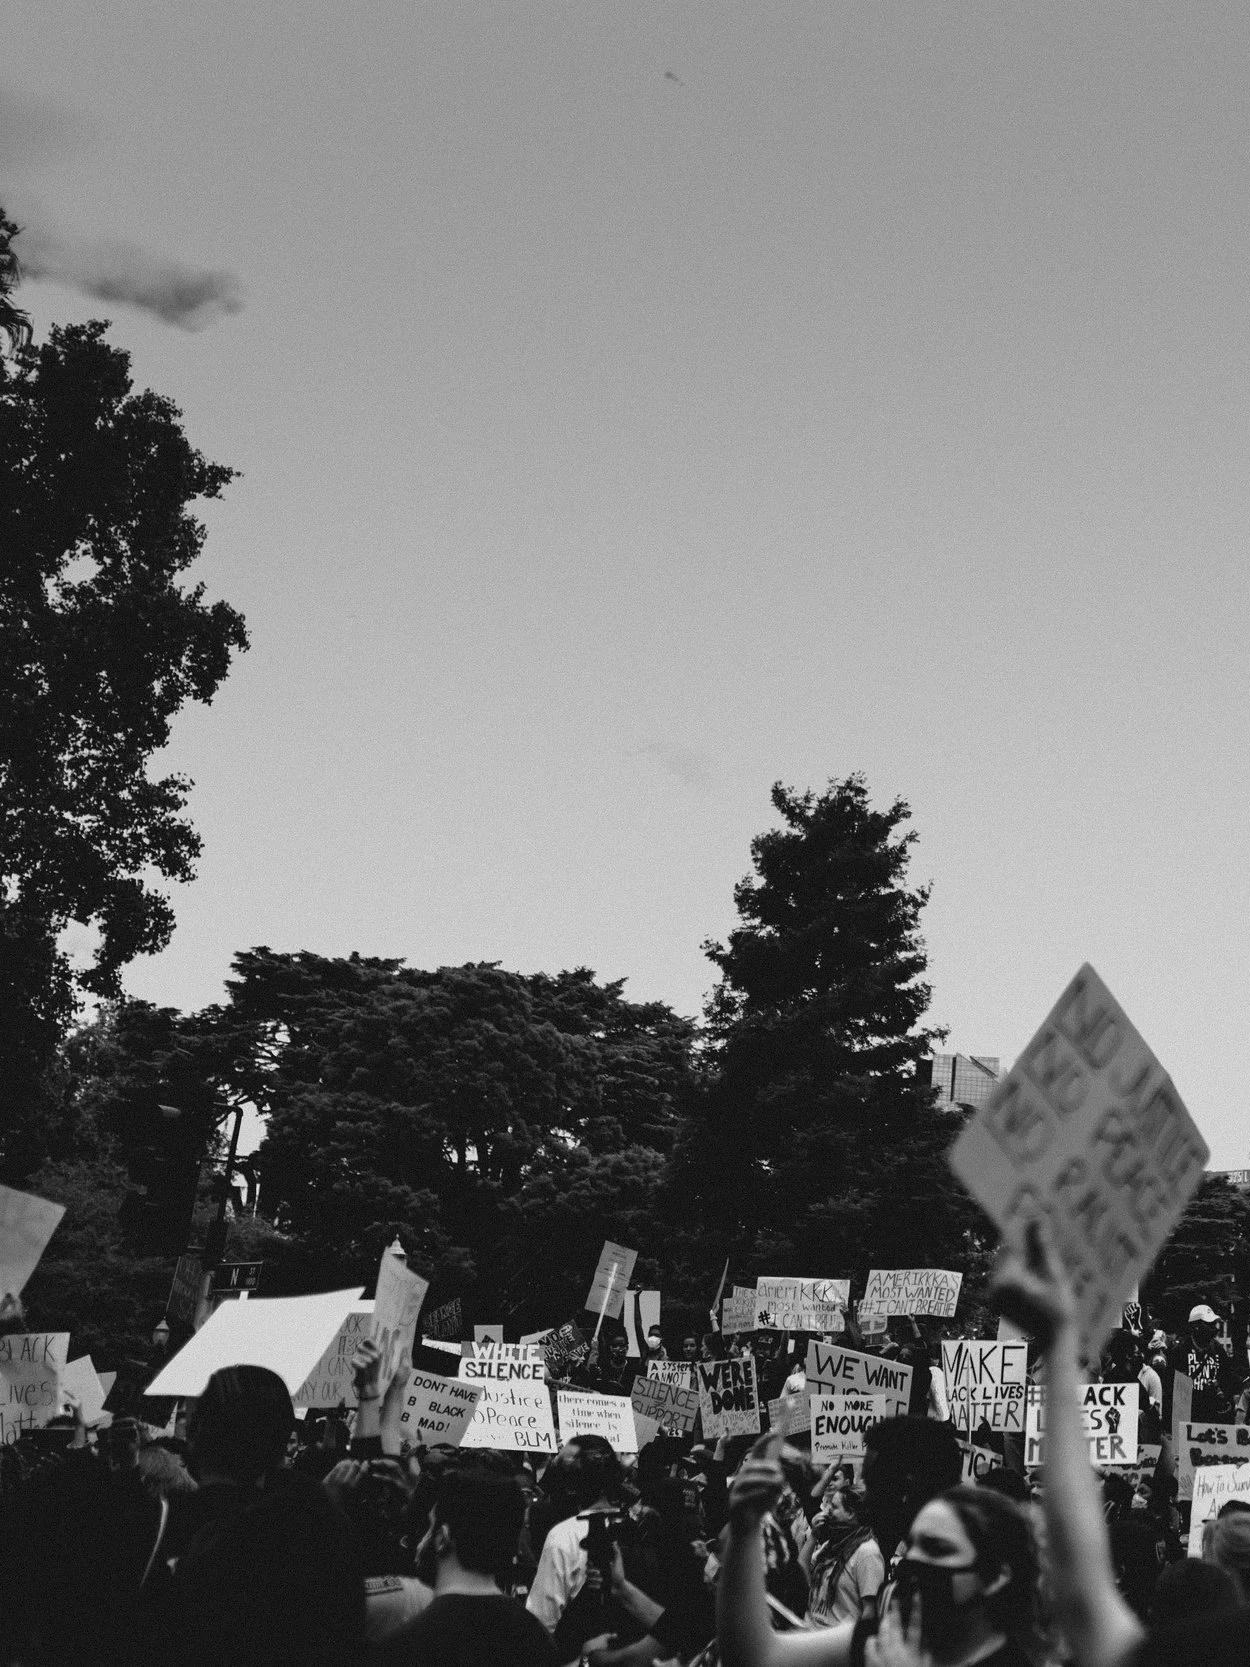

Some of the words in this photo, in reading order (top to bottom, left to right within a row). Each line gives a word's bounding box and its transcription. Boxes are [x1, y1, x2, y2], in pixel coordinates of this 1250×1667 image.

[1049, 974, 1133, 1074] NO
[1020, 1026, 1092, 1122] NO
[979, 1074, 1051, 1172] NO
[1244, 1171, 1248, 1182] L
[230, 1268, 239, 1286] N
[870, 1286, 901, 1299] MOST
[905, 1286, 955, 1302] WANTED
[471, 1341, 541, 1361] WHITE
[465, 1361, 544, 1381] SILENCE
[651, 1362, 659, 1371] A
[815, 1344, 860, 1380] WE
[864, 1361, 909, 1392] WANT
[943, 1342, 1025, 1387] MAKE
[649, 1372, 687, 1386] CANNOT
[699, 1360, 754, 1394] WERE
[413, 1376, 449, 1393] DONT
[450, 1386, 478, 1403] HAVE
[633, 1376, 699, 1412] SILENCE
[710, 1385, 756, 1415] DONE
[982, 1385, 1025, 1400] LIVES
[407, 1396, 417, 1407] B
[428, 1401, 466, 1419] BLACK
[572, 1408, 595, 1417] time
[596, 1409, 621, 1420] when
[631, 1400, 693, 1430] SUPPORT
[821, 1400, 835, 1412] NO
[844, 1400, 874, 1412] MORE
[401, 1412, 410, 1423] B
[418, 1417, 451, 1433] MAD!
[565, 1418, 601, 1429] silence
[514, 1431, 552, 1450] BLM
[1186, 1424, 1229, 1445] Let's
